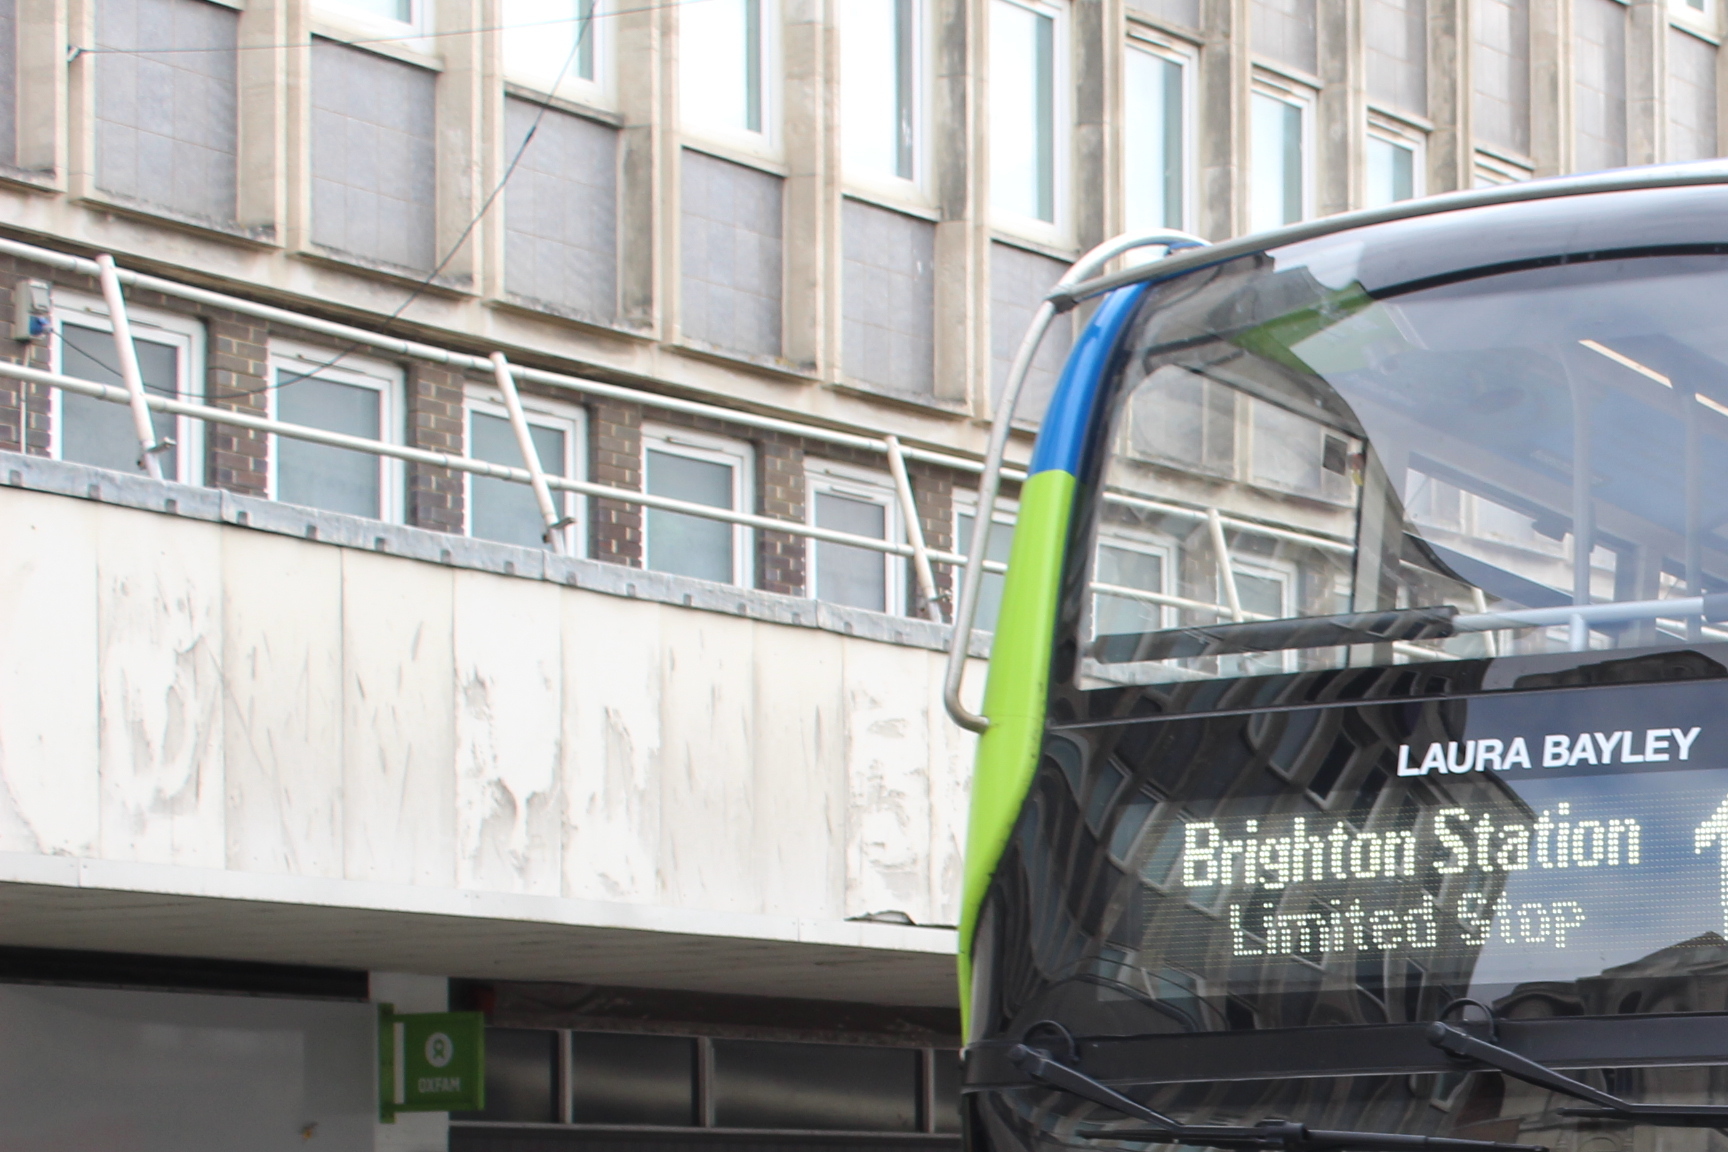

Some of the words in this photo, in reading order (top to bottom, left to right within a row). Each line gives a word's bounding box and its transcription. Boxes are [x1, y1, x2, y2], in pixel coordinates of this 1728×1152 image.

[1398, 736, 1533, 777] LAURA
[1542, 726, 1702, 769] BAYLEY
[1181, 816, 1416, 890] Brighton
[1432, 802, 1642, 876] Station
[1229, 895, 1438, 957] Limited
[1459, 892, 1588, 951] Stop
[417, 1076, 461, 1094] OXFAM
